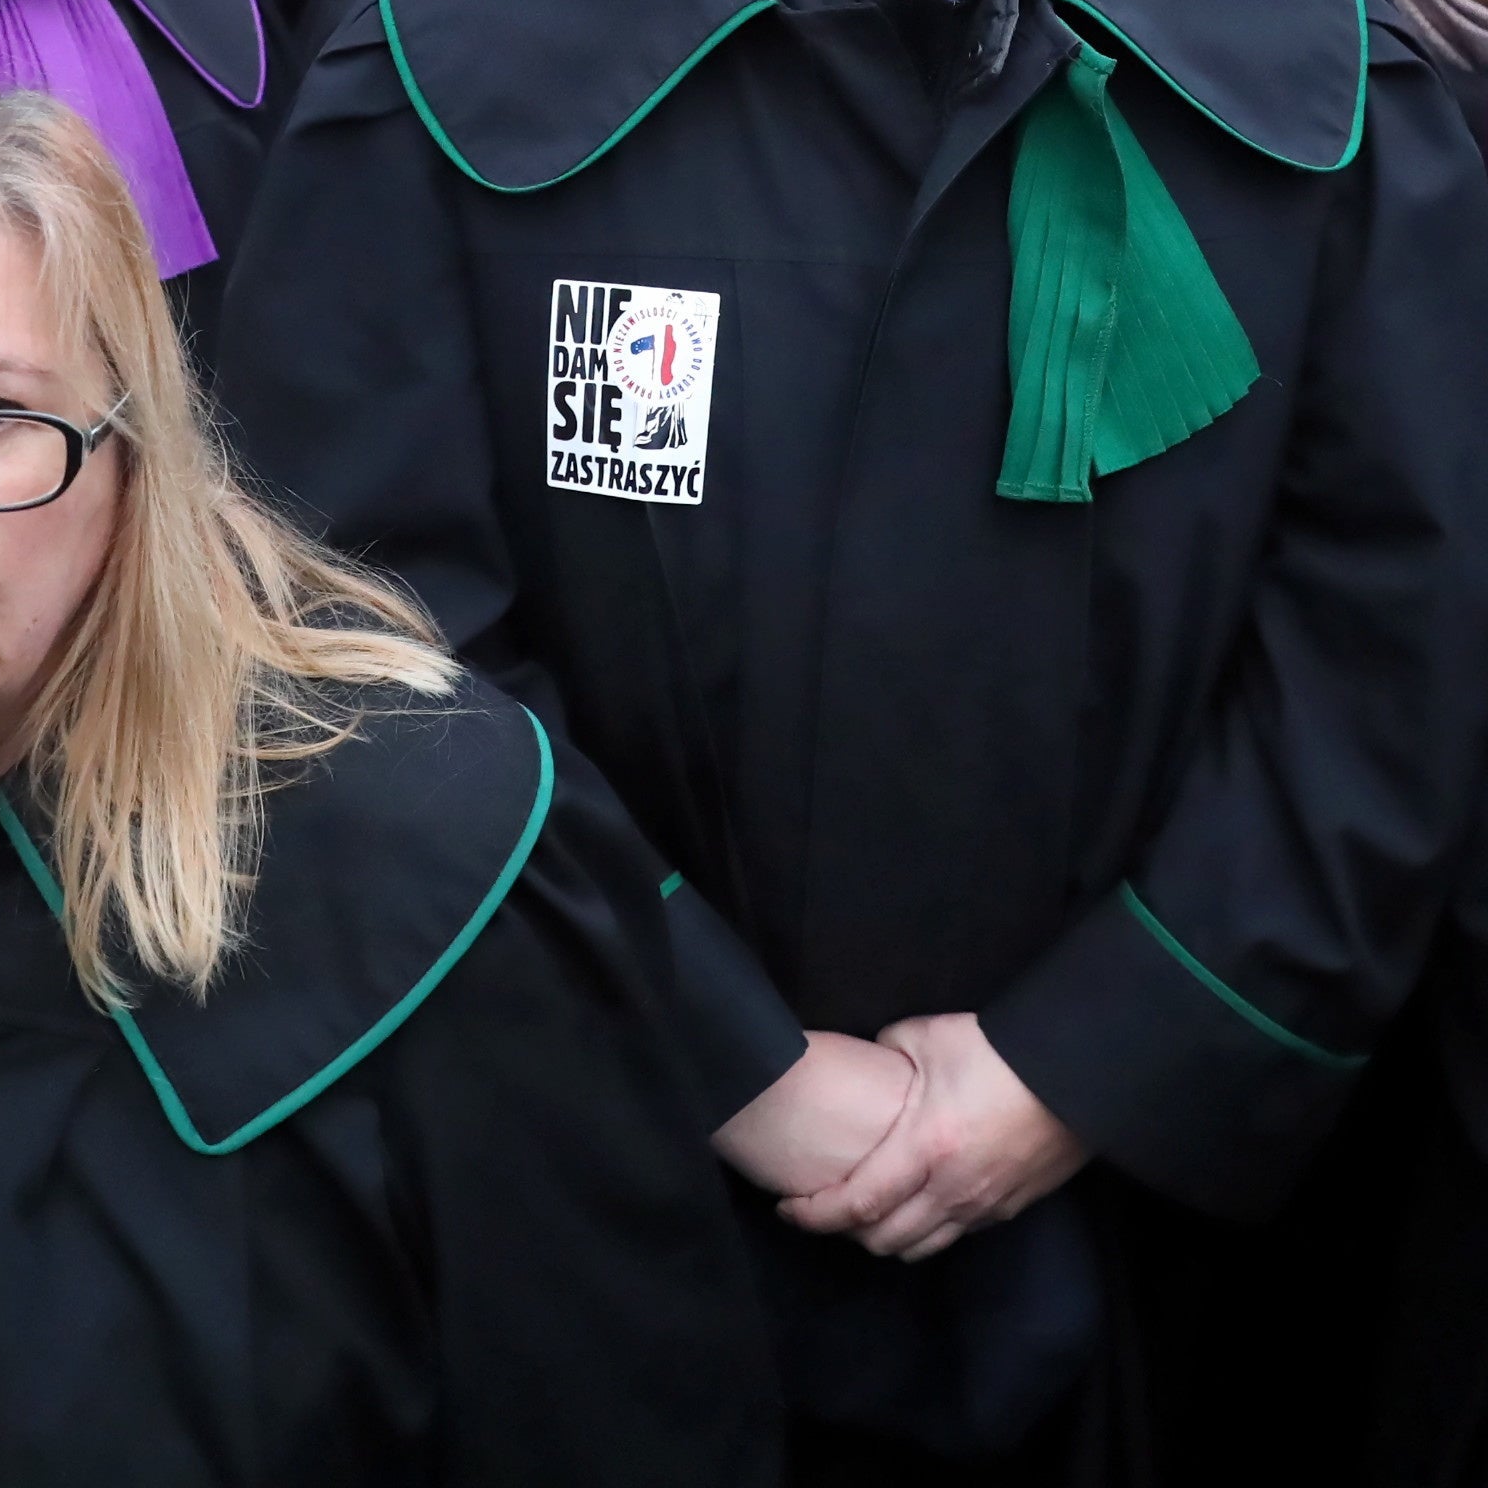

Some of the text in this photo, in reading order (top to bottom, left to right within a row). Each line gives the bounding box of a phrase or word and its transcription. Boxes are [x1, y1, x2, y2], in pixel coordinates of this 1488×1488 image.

[555, 283, 632, 346] NIE
[552, 344, 609, 382] DAM
[552, 380, 623, 454] SIĘ
[550, 450, 700, 498] ZASTRASZYĆ
